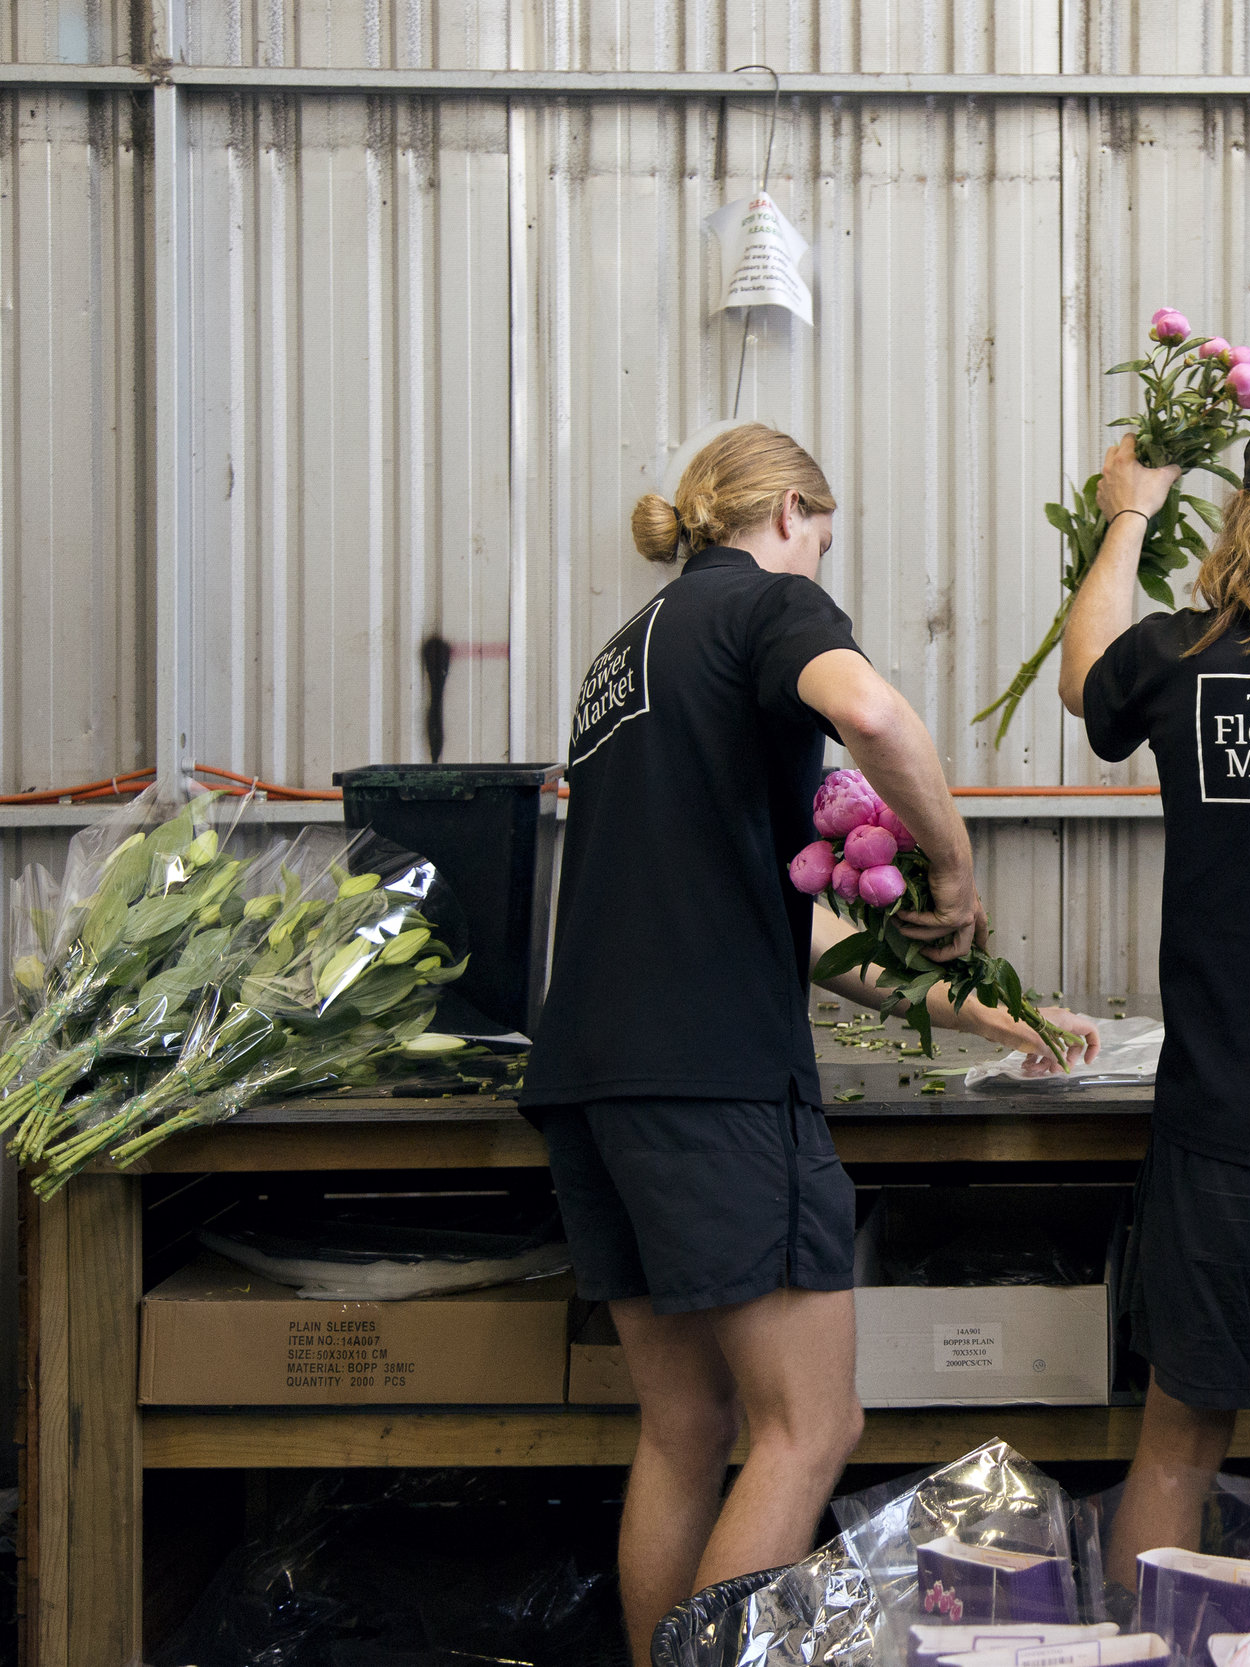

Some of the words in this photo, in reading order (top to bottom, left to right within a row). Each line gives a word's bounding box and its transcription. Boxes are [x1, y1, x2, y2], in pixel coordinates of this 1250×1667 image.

[591, 646, 617, 677] The
[576, 645, 631, 711] lower
[574, 667, 635, 742] Market
[289, 1321, 321, 1332] PLAIN
[326, 1321, 376, 1332] SLEEVES
[288, 1335, 314, 1346] ITEM
[371, 1348, 388, 1359] CM
[287, 1362, 345, 1374] MATERIAL:
[347, 1363, 378, 1373] BOPP
[383, 1362, 415, 1373] 38MIC
[350, 1376, 375, 1387] 2000
[384, 1376, 406, 1387] PCS
